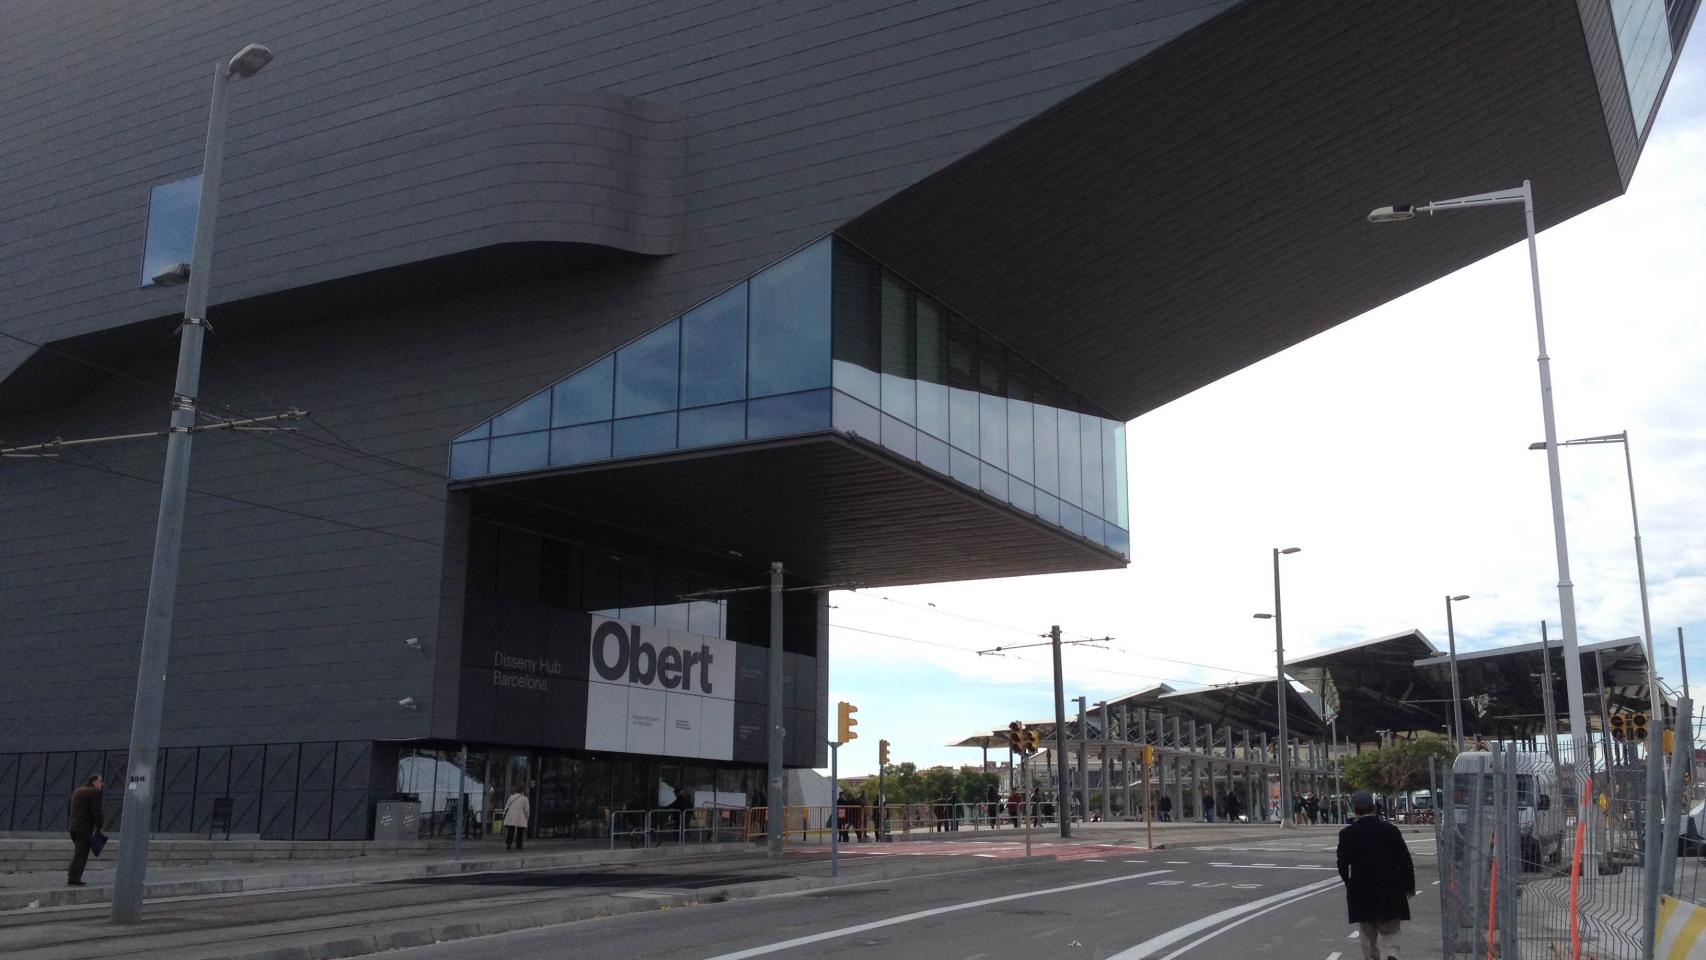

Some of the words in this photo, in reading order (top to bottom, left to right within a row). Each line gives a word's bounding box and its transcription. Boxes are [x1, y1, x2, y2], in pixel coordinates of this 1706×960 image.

[494, 651, 537, 673] Disseny
[540, 656, 561, 674] Hub
[592, 621, 713, 694] Obert
[493, 670, 548, 691] Barcelona
[1147, 880, 1264, 889] BUS
